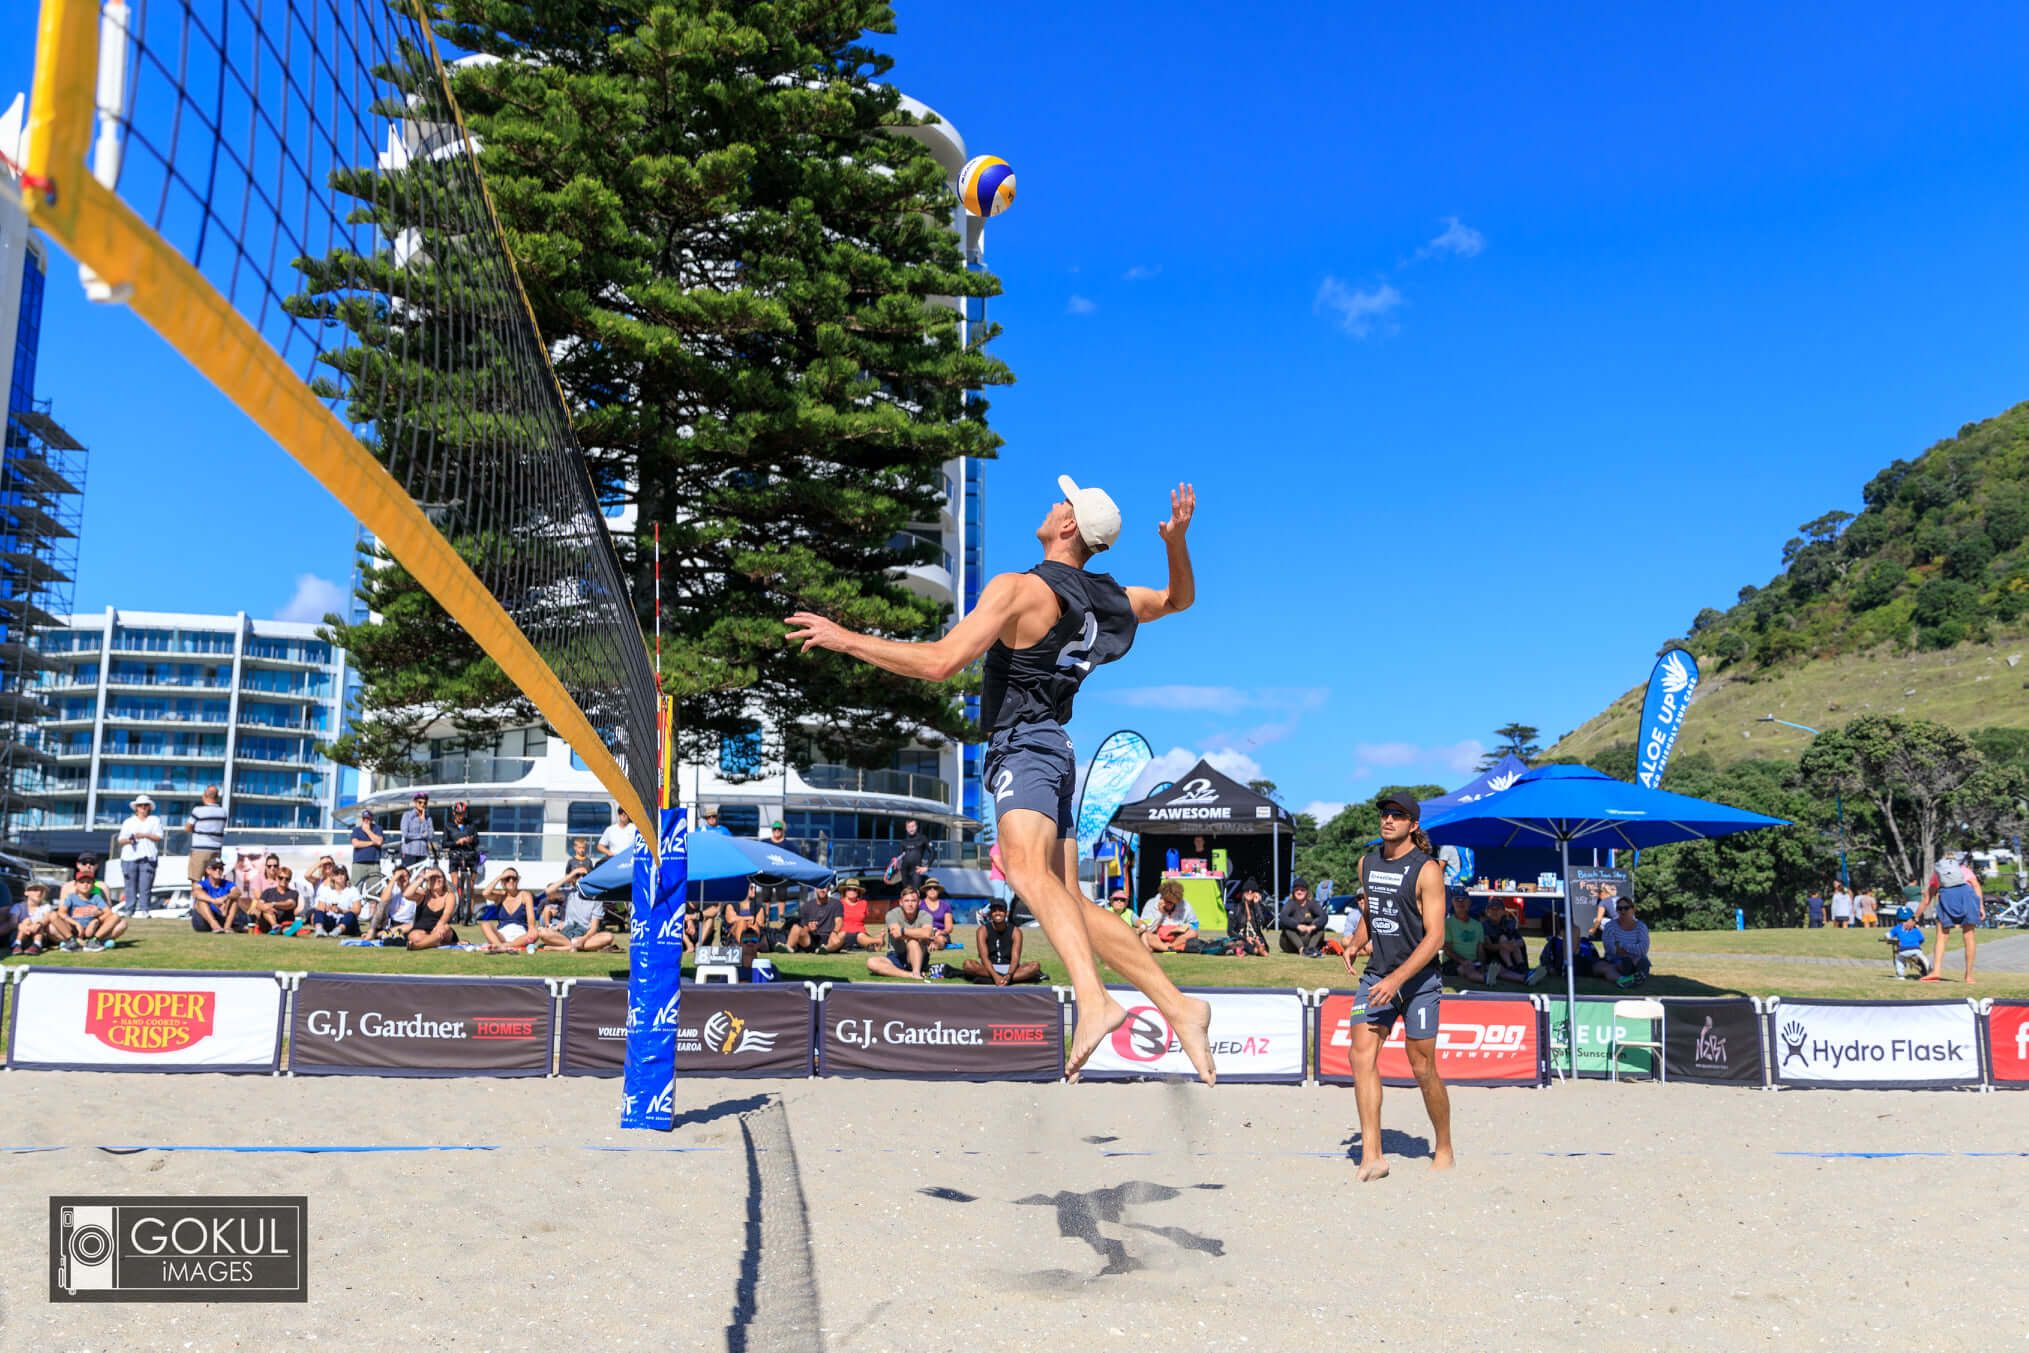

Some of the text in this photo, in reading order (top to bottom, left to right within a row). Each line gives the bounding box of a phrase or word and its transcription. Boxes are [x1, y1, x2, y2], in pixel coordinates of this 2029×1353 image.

[1056, 611, 1098, 671] 2
[1658, 726, 1678, 771] FRIENDLY
[1675, 704, 1687, 722] SUN
[1684, 677, 1697, 701] CARE
[1639, 693, 1677, 789] ALOE UP
[995, 770, 1014, 803] 2
[1148, 807, 1232, 820] 2AWESOME
[727, 948, 740, 962] 12
[96, 992, 206, 1022] PROPER
[1417, 1007, 1426, 1029] 1
[108, 1025, 190, 1048] CRISPS
[307, 1010, 533, 1042] G.J. Gardner. HOMES
[598, 1027, 628, 1037] VOLLEY
[836, 1019, 1044, 1049] G.J. Gardner. HOMES
[1596, 1026, 1626, 1044] UP
[1813, 1040, 1964, 1068] Hydro Flask
